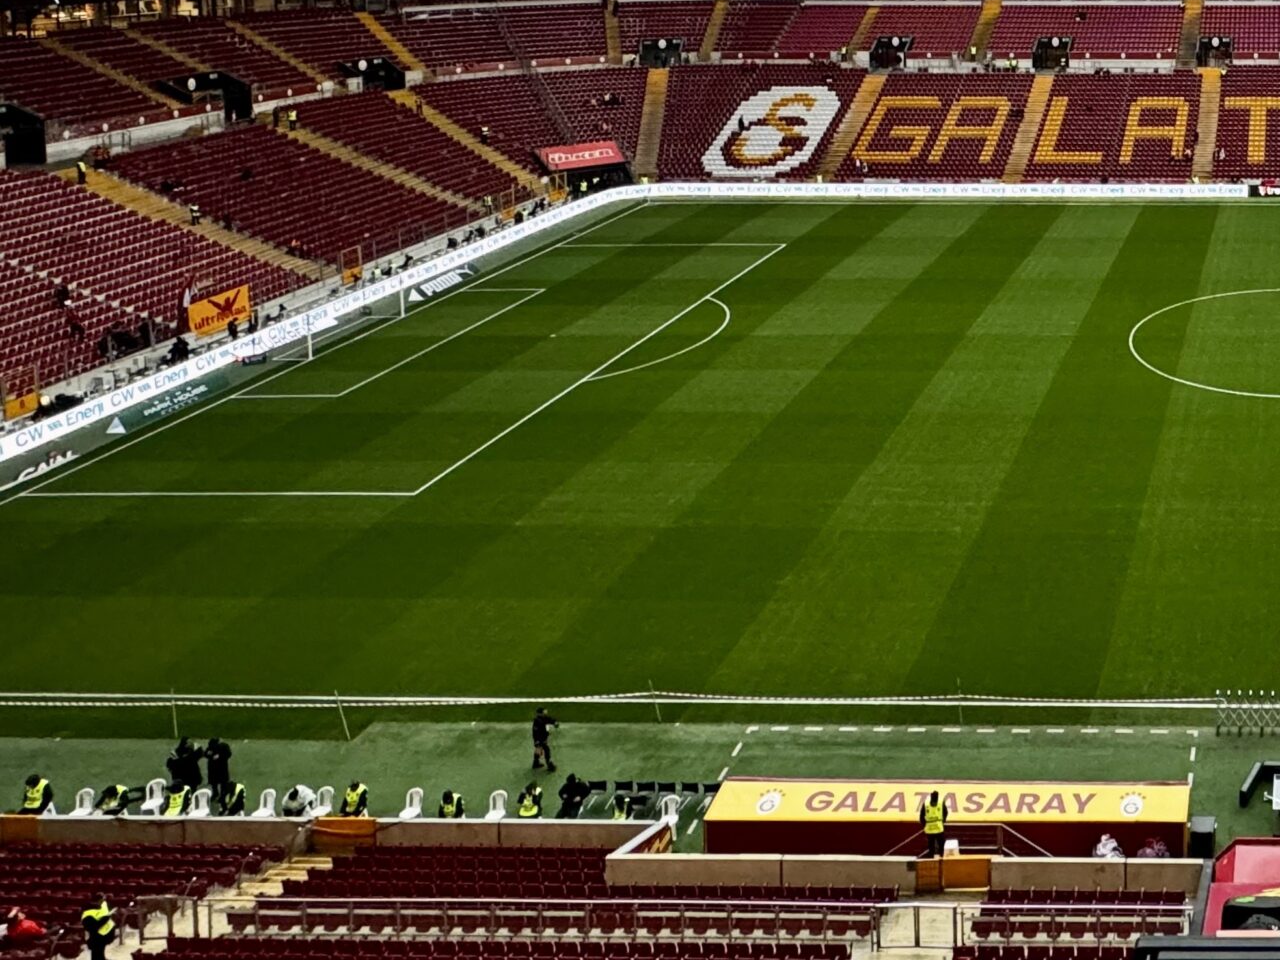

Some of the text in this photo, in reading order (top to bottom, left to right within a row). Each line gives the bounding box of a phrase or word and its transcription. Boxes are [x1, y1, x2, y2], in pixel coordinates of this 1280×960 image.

[15, 424, 43, 447] CW
[111, 385, 134, 407] CW
[195, 352, 216, 371] CW
[805, 790, 1096, 815] GALATASARAY
